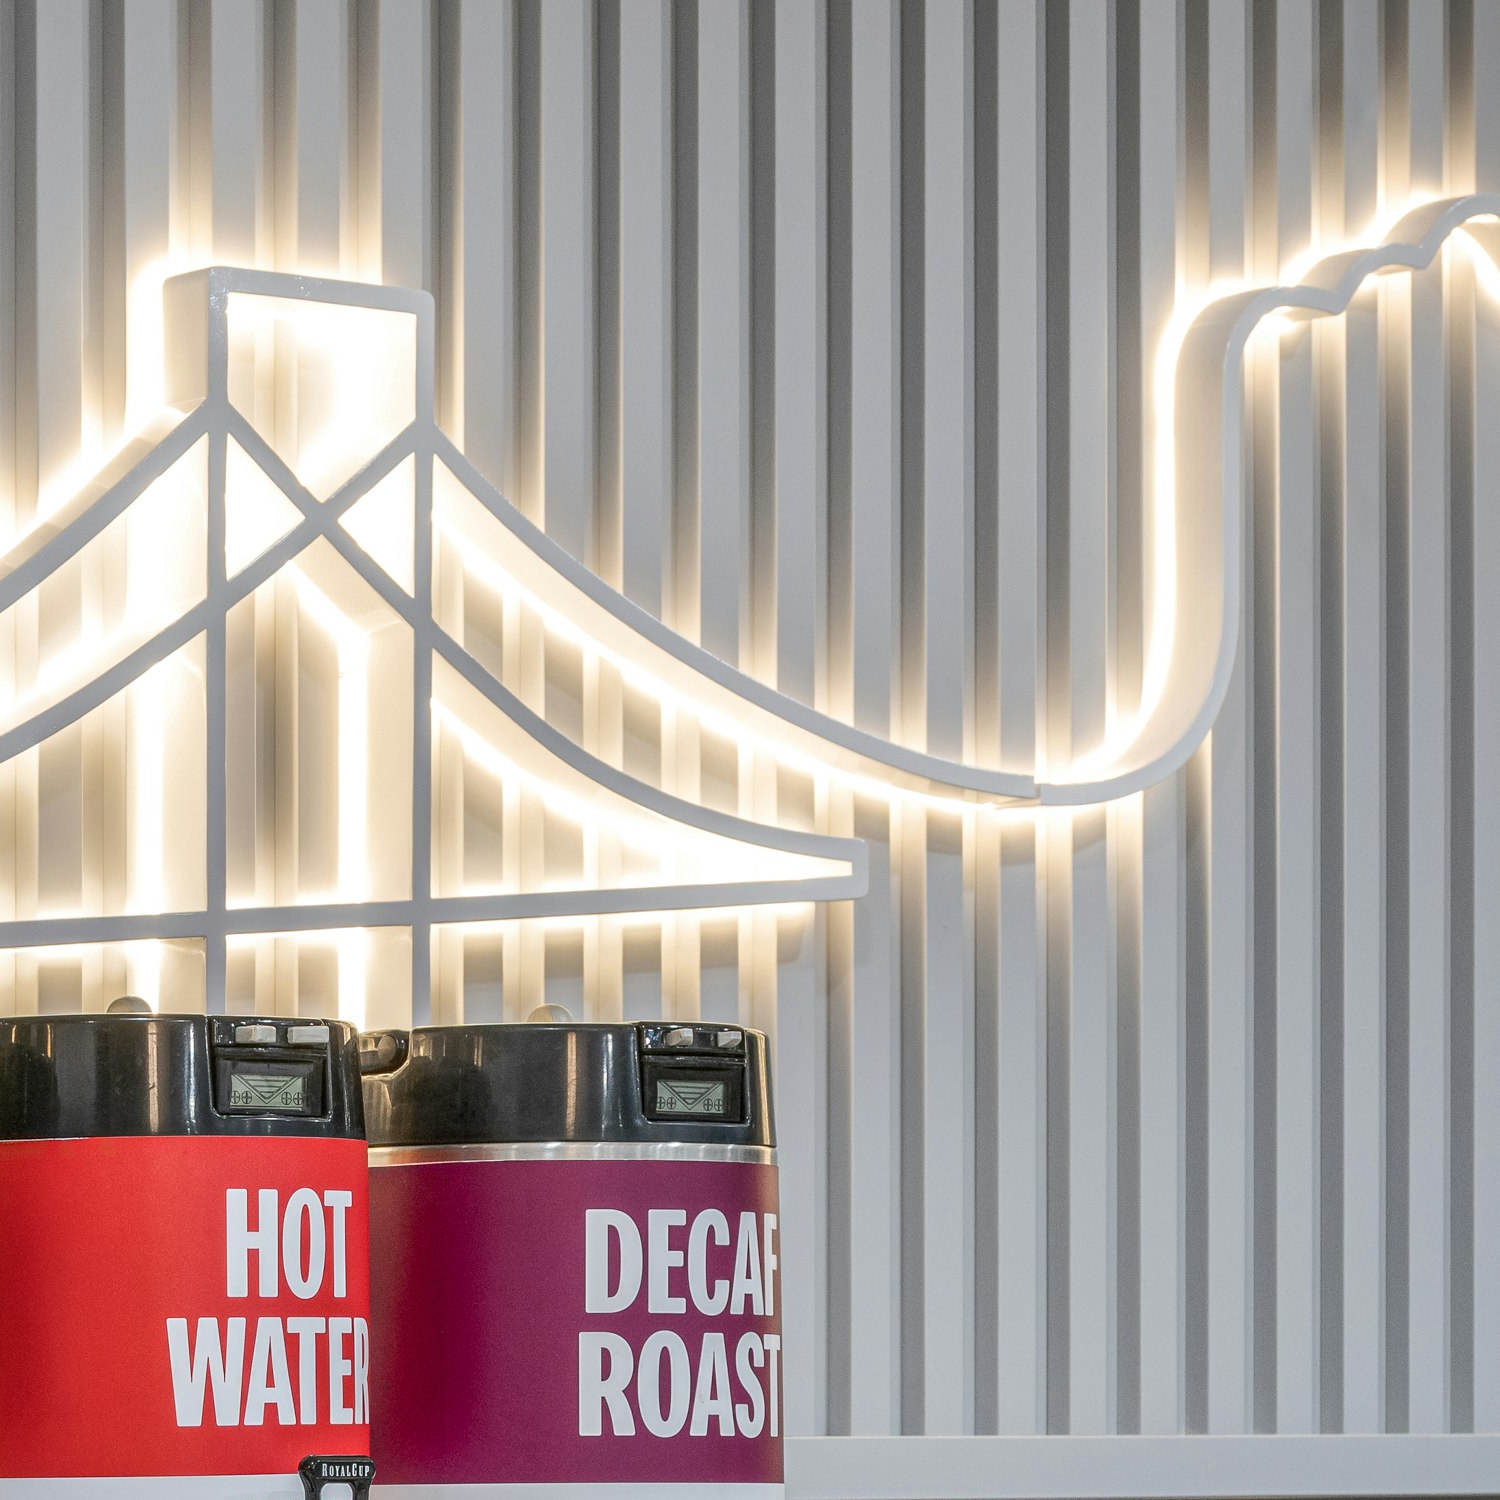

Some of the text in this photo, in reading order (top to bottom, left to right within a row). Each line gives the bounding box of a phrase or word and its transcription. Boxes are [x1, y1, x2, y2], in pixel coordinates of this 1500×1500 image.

[226, 1187, 352, 1299] HOT
[585, 1208, 778, 1316] DECAF
[166, 1316, 370, 1427] WATER
[578, 1329, 780, 1439] ROAST
